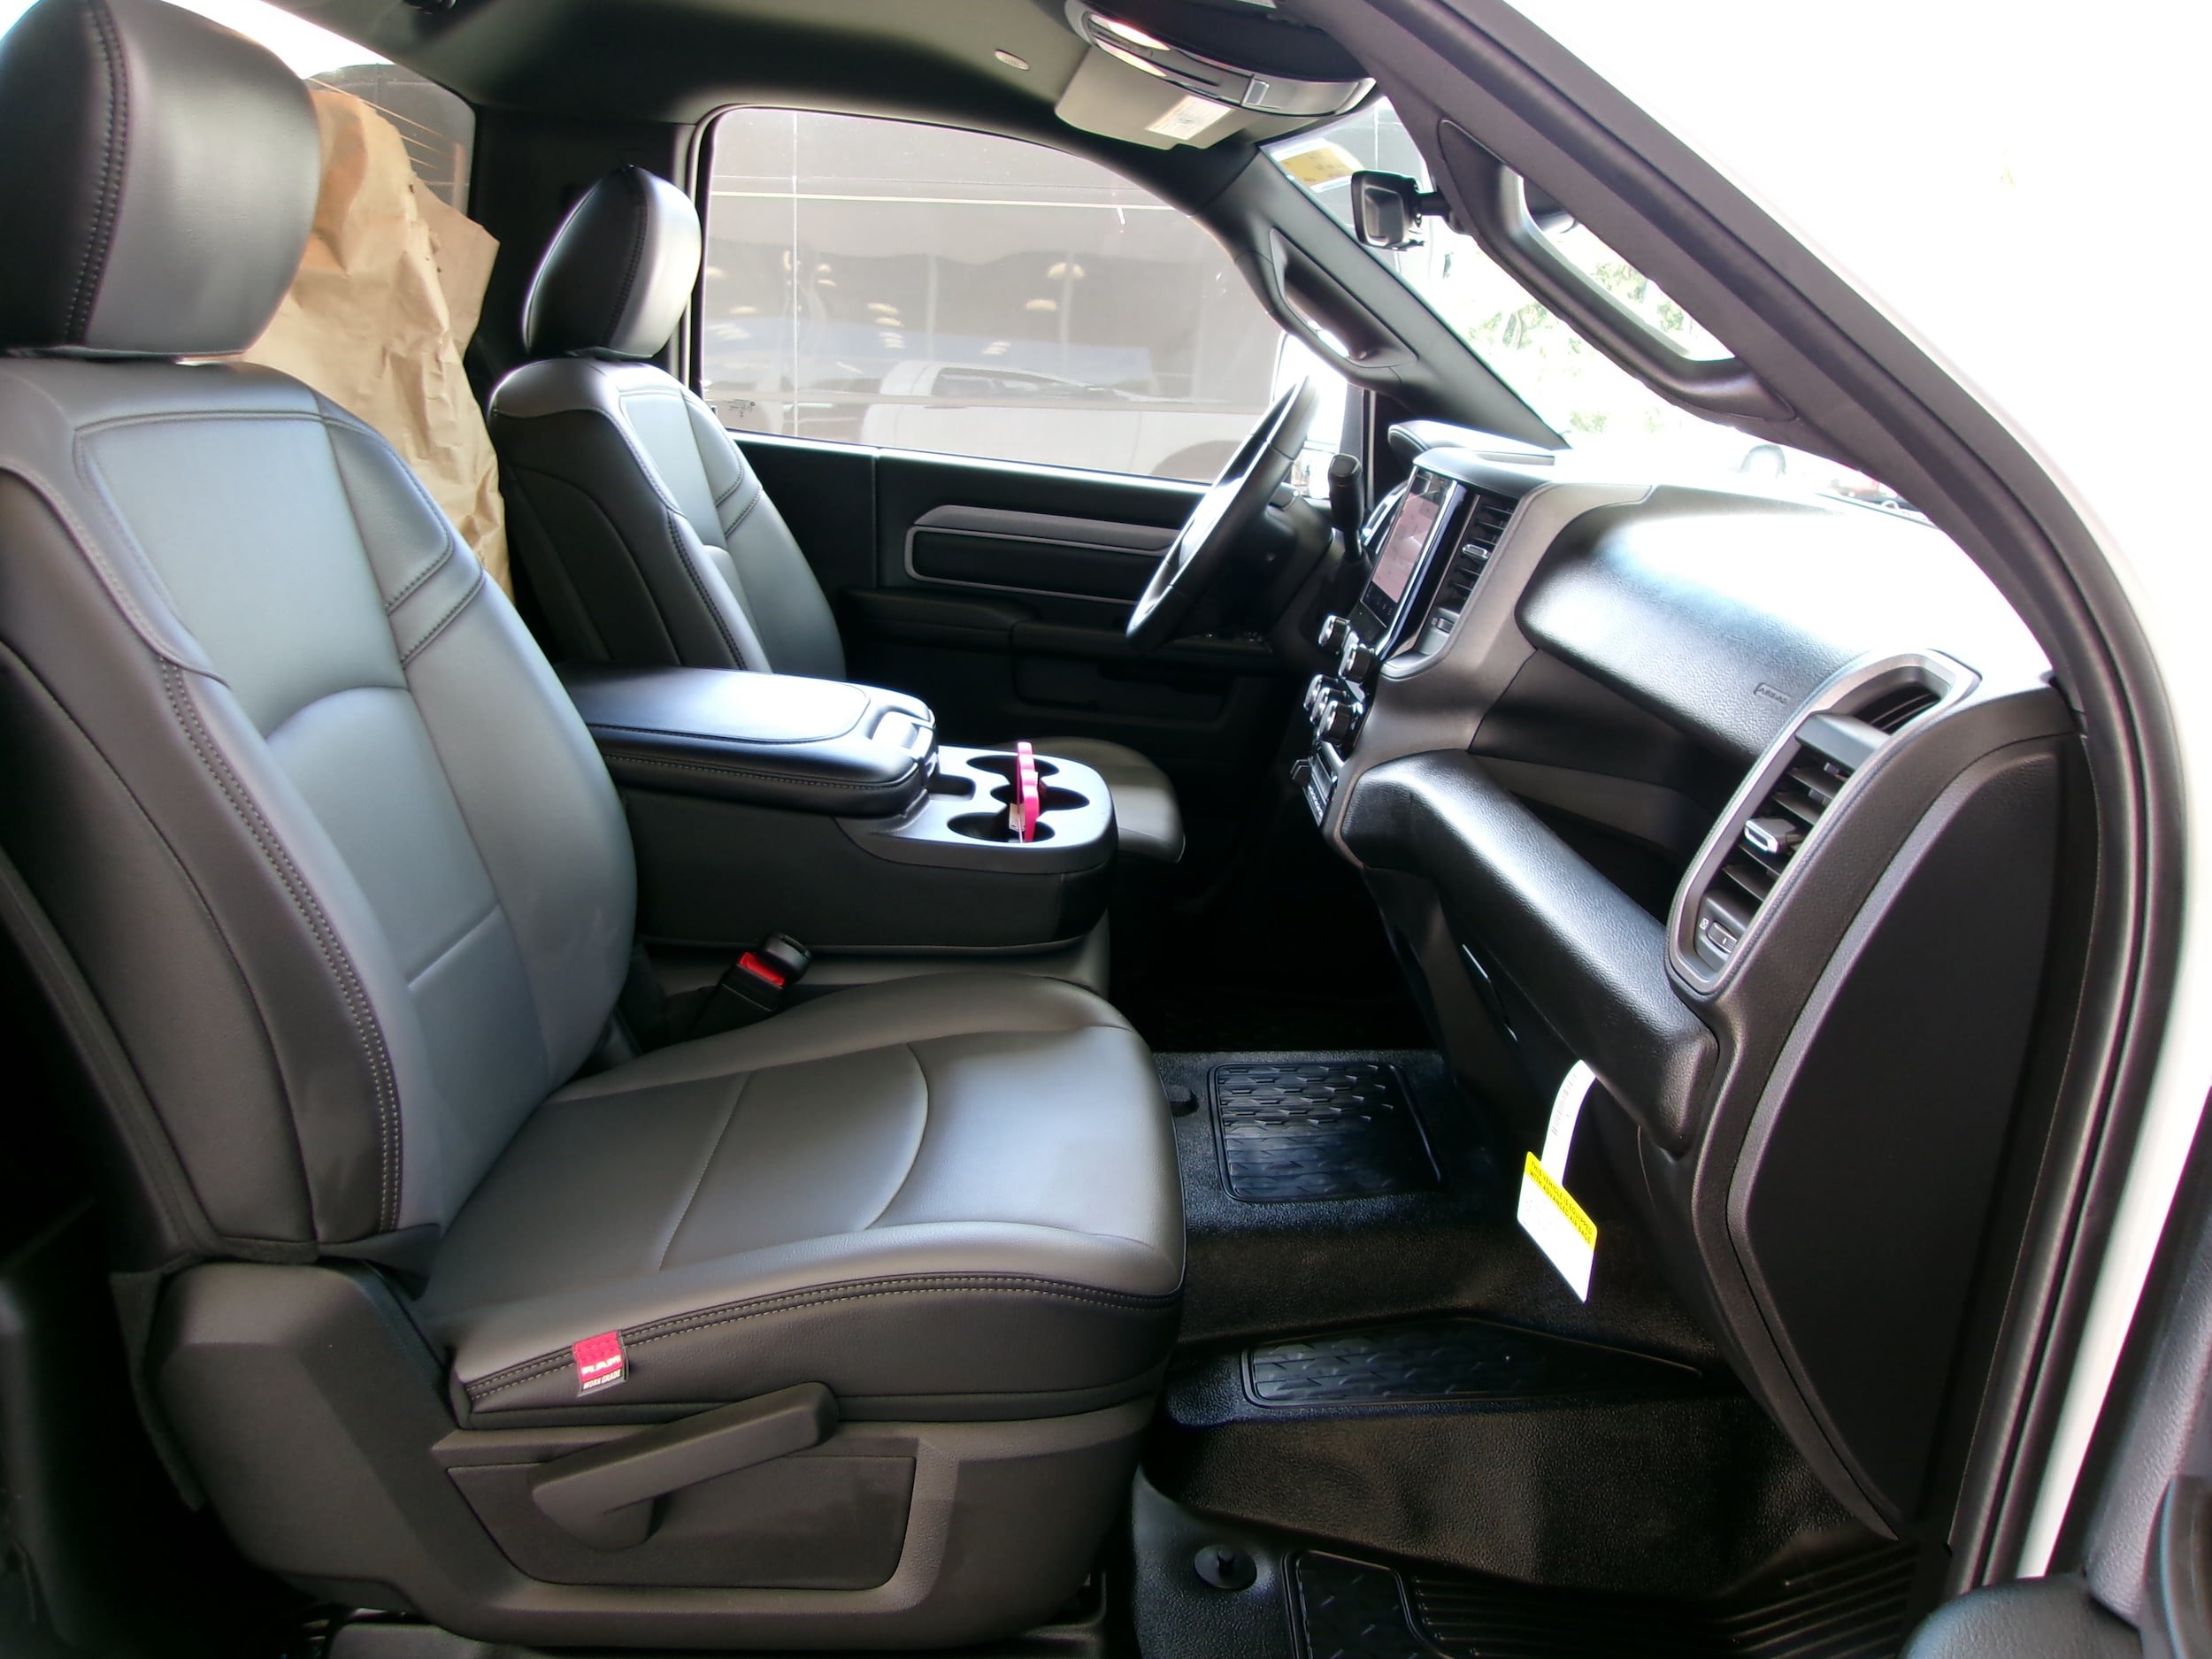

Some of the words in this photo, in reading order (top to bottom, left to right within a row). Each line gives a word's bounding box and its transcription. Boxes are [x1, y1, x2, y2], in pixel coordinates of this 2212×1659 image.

[1530, 1171, 1542, 1187] WITH
[1542, 1185, 1569, 1217] ADVANCED
[1531, 1160, 1542, 1177] THIS
[1543, 1176, 1563, 1200] VEHICLE
[1569, 1203, 1593, 1235] EQUIPPED
[580, 1356, 621, 1375] RAM
[583, 1378, 602, 1390] WORK
[602, 1369, 621, 1384] GRADE
